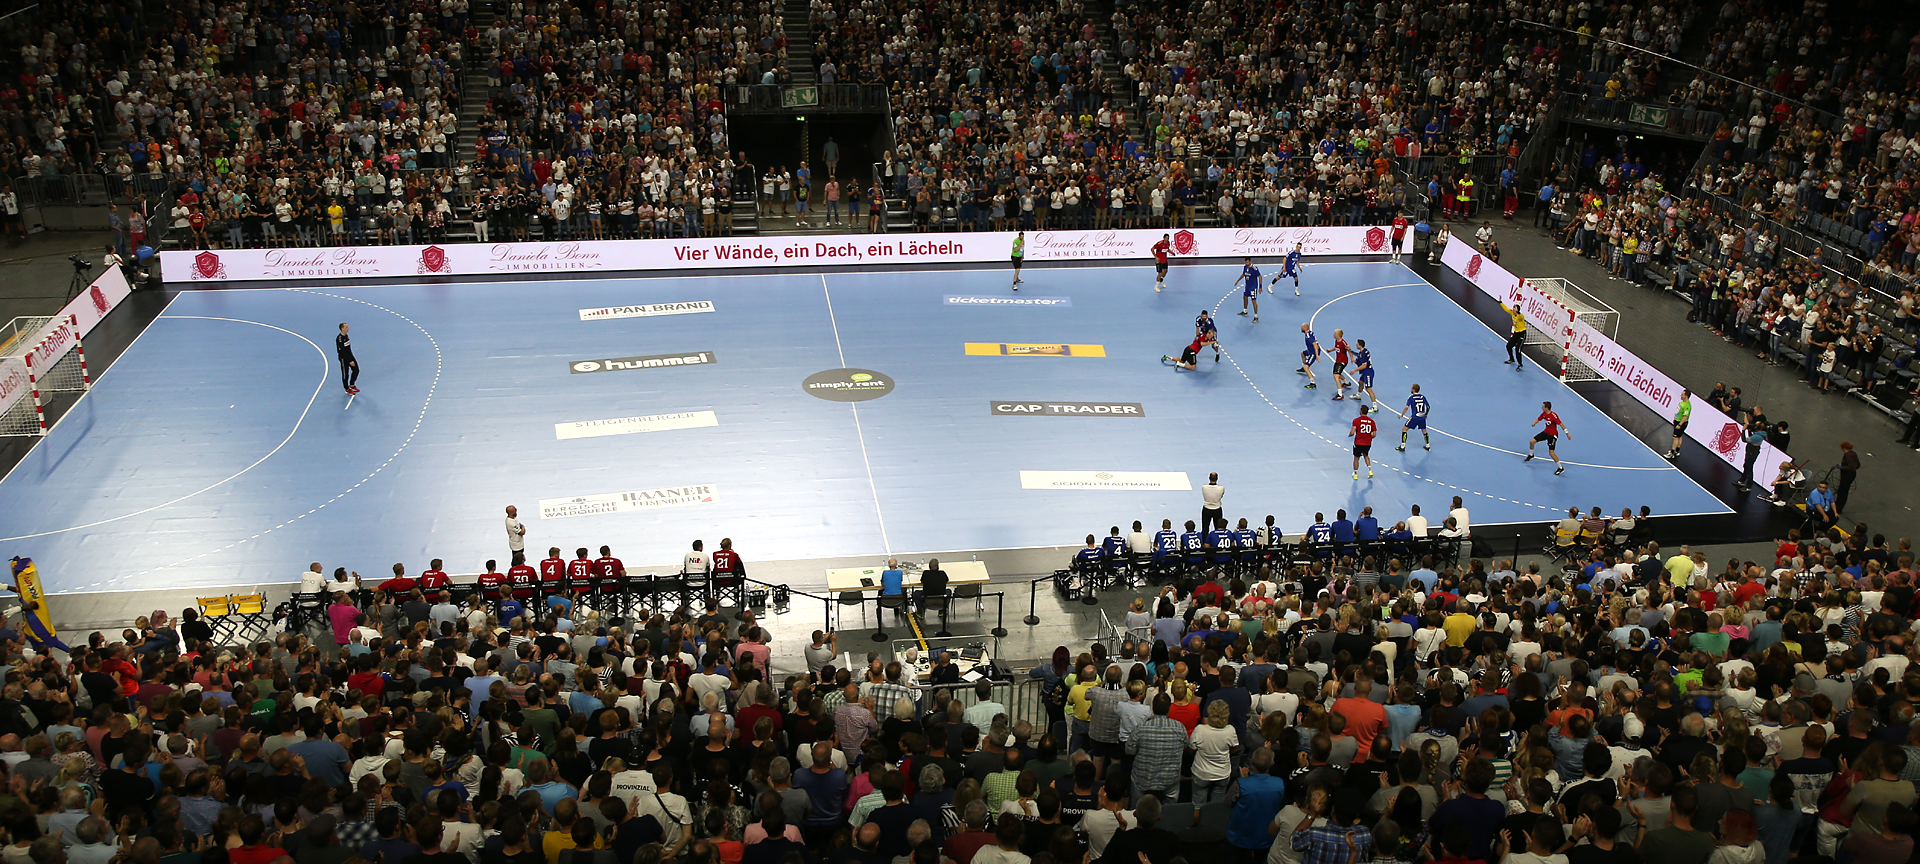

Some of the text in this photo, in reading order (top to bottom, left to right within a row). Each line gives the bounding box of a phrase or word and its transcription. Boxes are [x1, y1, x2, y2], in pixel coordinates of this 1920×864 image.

[1033, 230, 1134, 249] Daniela Bonn
[1233, 228, 1330, 246] Daniela Bonn
[489, 241, 600, 262] Daniela Bonn
[674, 240, 963, 262] Vier Wände, ein Dach, ein Lächeln
[264, 248, 378, 267] Daniela Bonn
[506, 262, 585, 270] IMMOBILIEN
[281, 268, 362, 276] IMMOBILIEN
[948, 296, 1061, 305] ticketmaster
[1527, 296, 1559, 335] Wände,
[1561, 325, 1577, 341] en
[1578, 333, 1605, 368] Dach,
[1608, 356, 1626, 377] ein
[1626, 365, 1672, 408] Lächeln
[605, 353, 708, 371] hummel
[809, 381, 853, 389] simply
[997, 404, 1139, 414] CAP TRADER
[1415, 403, 1424, 412] 17
[575, 412, 695, 428] STEIGENBERGER
[1360, 424, 1372, 434] 20
[622, 486, 711, 502] HAANER
[544, 501, 617, 513] BERGISCHE
[544, 506, 618, 518] WALDQUELLE
[1317, 531, 1331, 543] 24
[1163, 538, 1176, 549] 23
[1188, 538, 1202, 549] 83
[1218, 538, 1231, 549] 40
[1114, 545, 1122, 555] 4
[717, 558, 729, 569] 21
[546, 564, 556, 575] 4
[574, 565, 587, 576] 31
[604, 565, 613, 576] 2
[427, 577, 435, 588] 7
